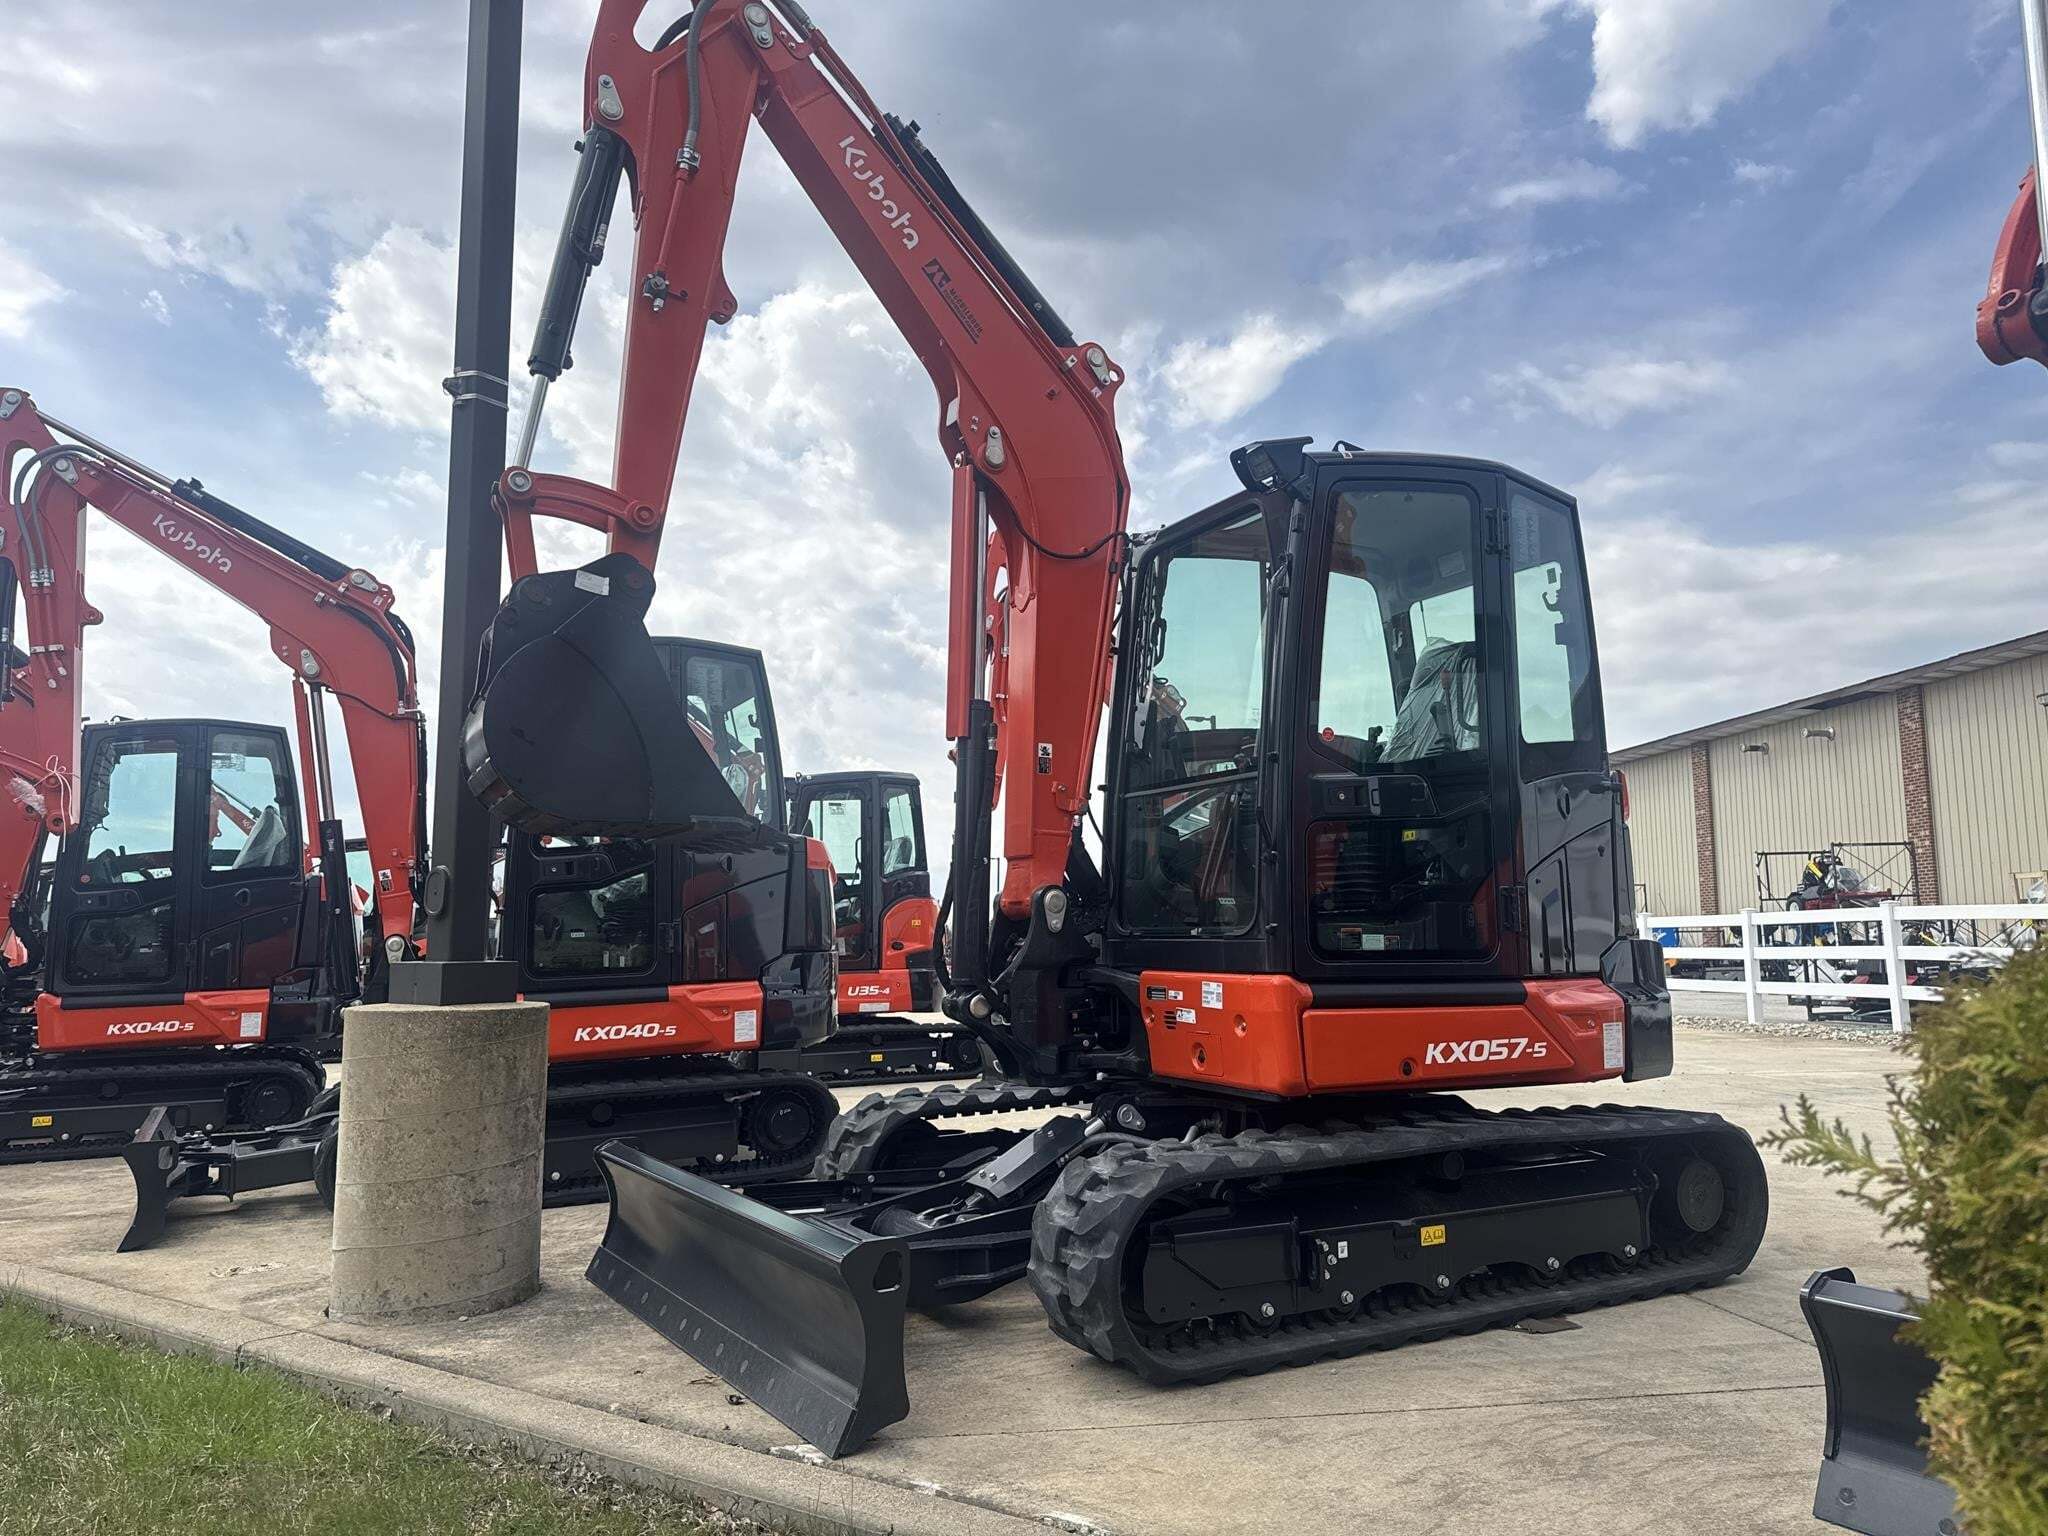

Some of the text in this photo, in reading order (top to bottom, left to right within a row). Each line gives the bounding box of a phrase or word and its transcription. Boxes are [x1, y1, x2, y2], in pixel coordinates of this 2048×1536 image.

[838, 135, 920, 250] Kubota
[152, 513, 232, 573] Kubota
[847, 985, 890, 997] U35-4
[106, 1020, 195, 1036] KX040-5
[574, 1022, 677, 1042] KX040-5
[1425, 1037, 1547, 1065] KX057-5
